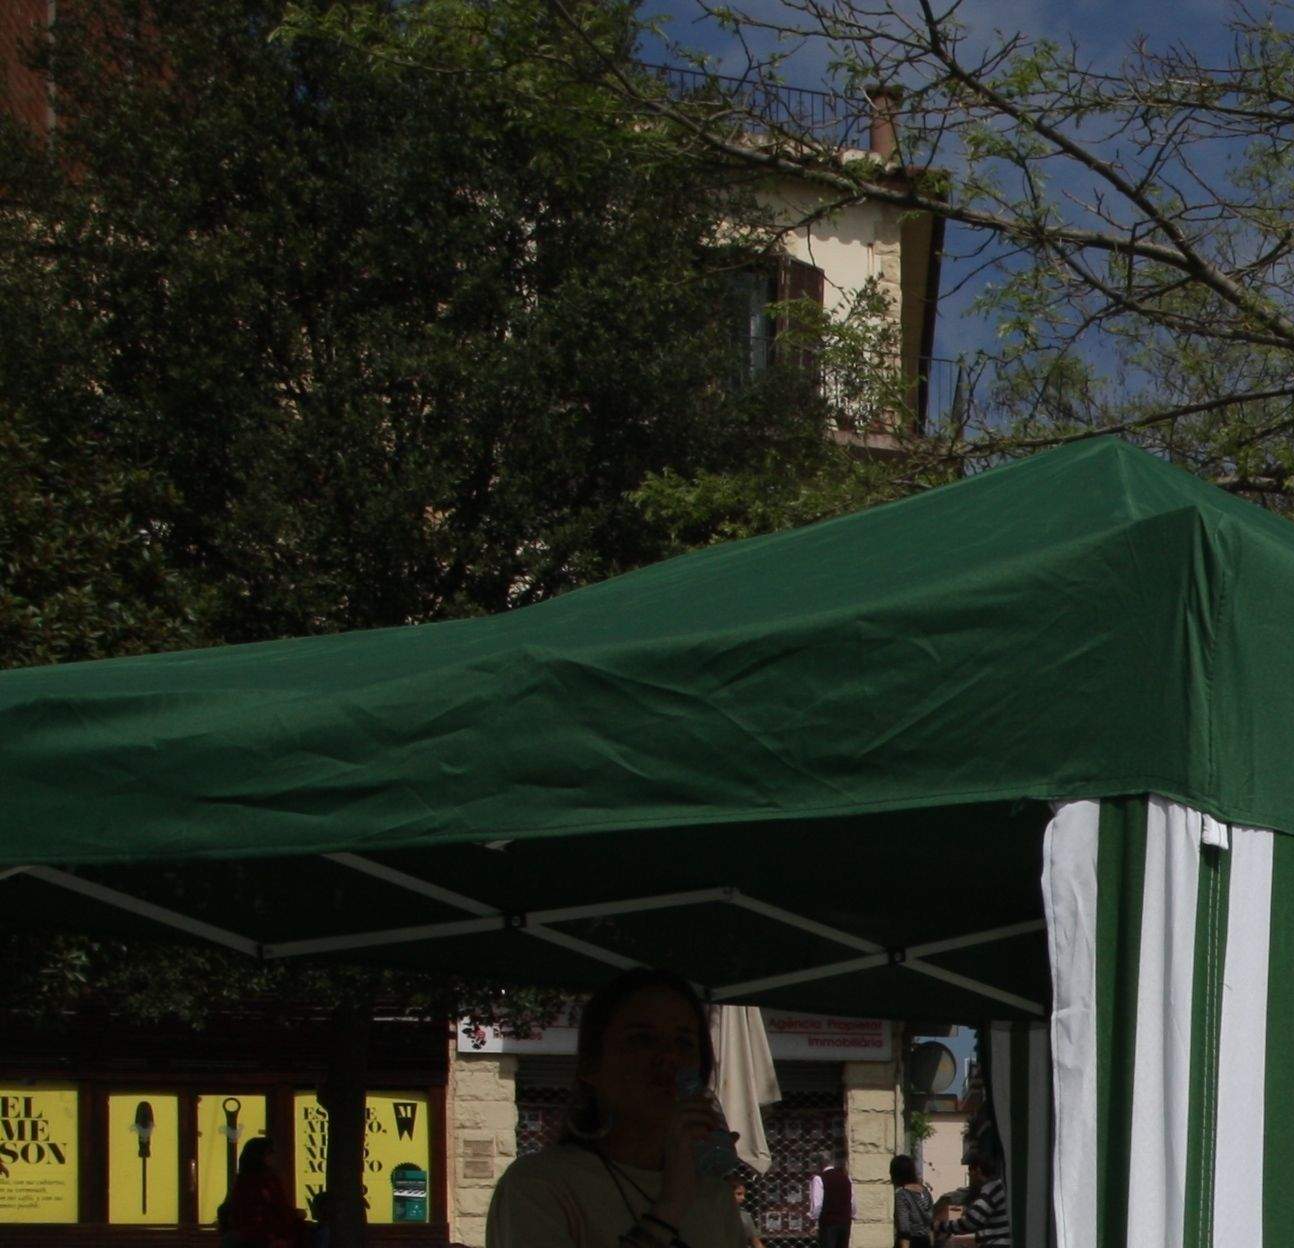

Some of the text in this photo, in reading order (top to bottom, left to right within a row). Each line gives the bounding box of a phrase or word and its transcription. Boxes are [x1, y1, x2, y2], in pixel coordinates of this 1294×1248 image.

[768, 1015, 883, 1032] Agència Propietat
[808, 1036, 883, 1048] Immobiliària
